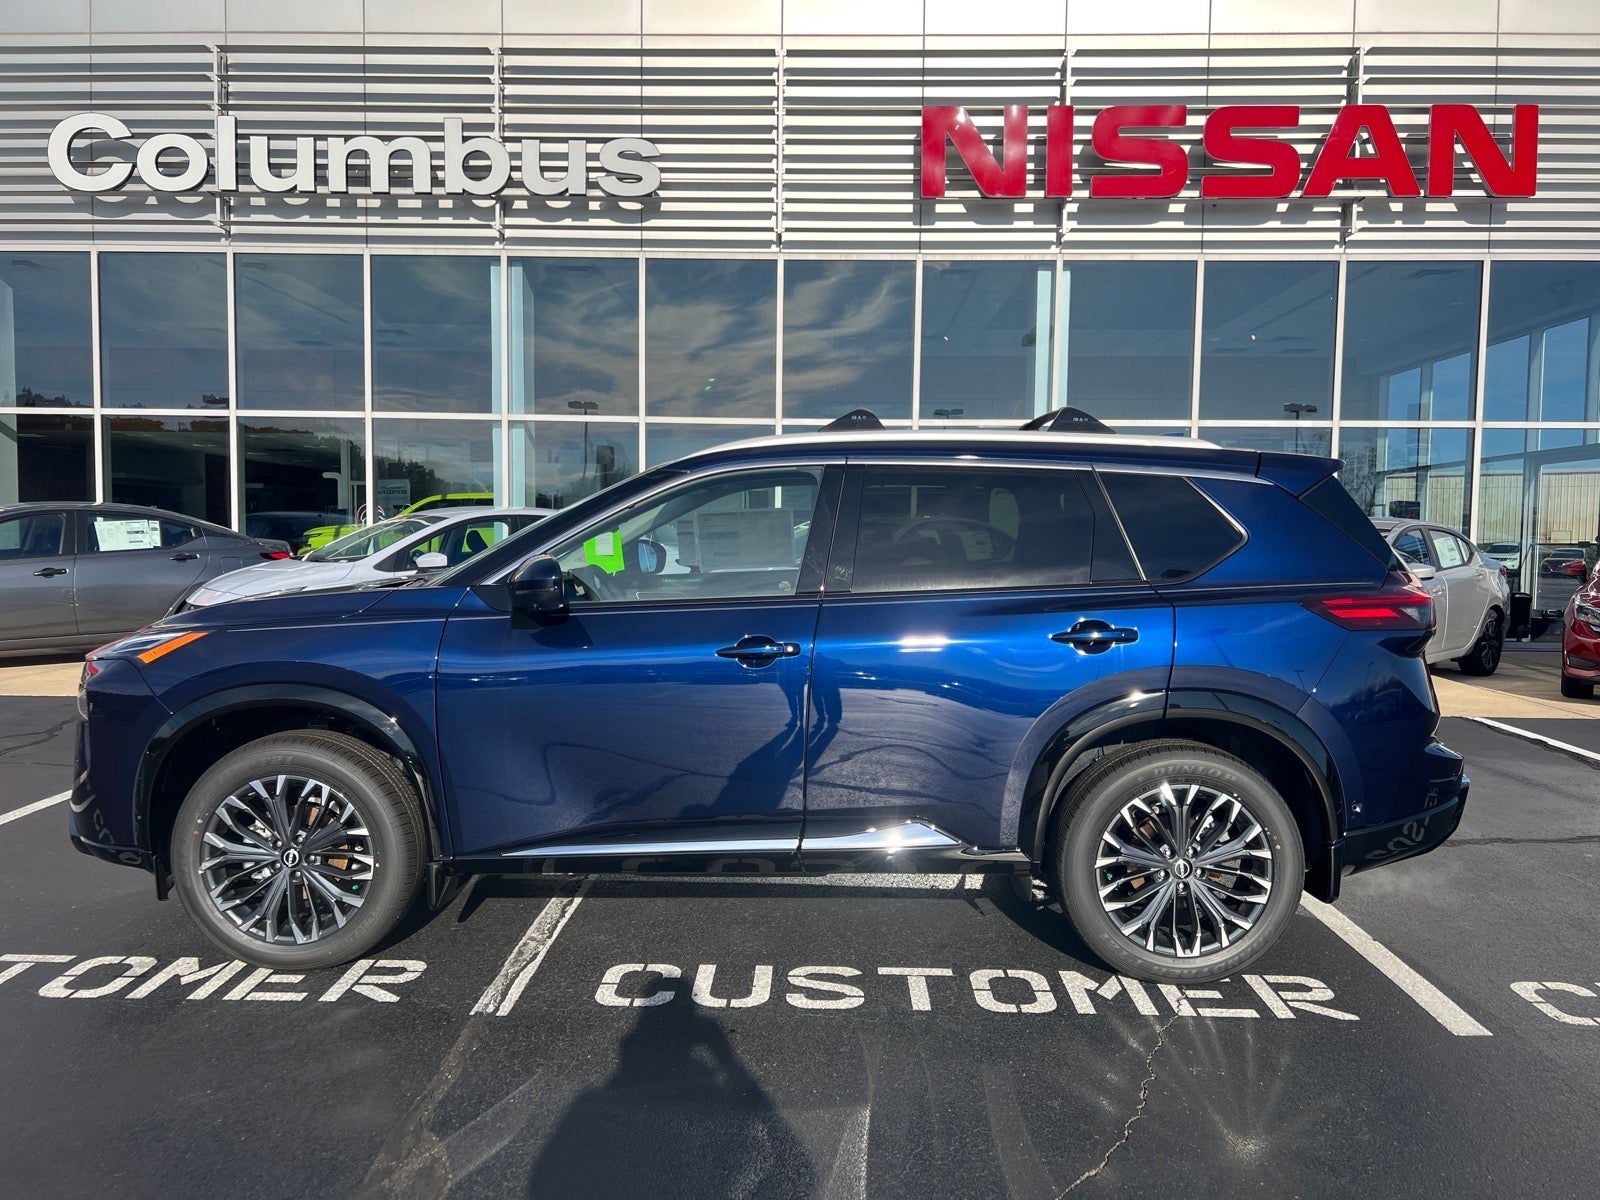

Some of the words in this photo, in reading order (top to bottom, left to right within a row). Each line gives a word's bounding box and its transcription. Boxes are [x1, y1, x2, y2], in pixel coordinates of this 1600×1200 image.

[47, 112, 662, 197] Columbus
[921, 104, 1539, 199] NISSAN
[1152, 763, 1237, 784] DUNLOP
[0, 954, 428, 1002] TOMER
[594, 963, 1360, 1021] CUSTOMER
[1510, 981, 1600, 1026] C
